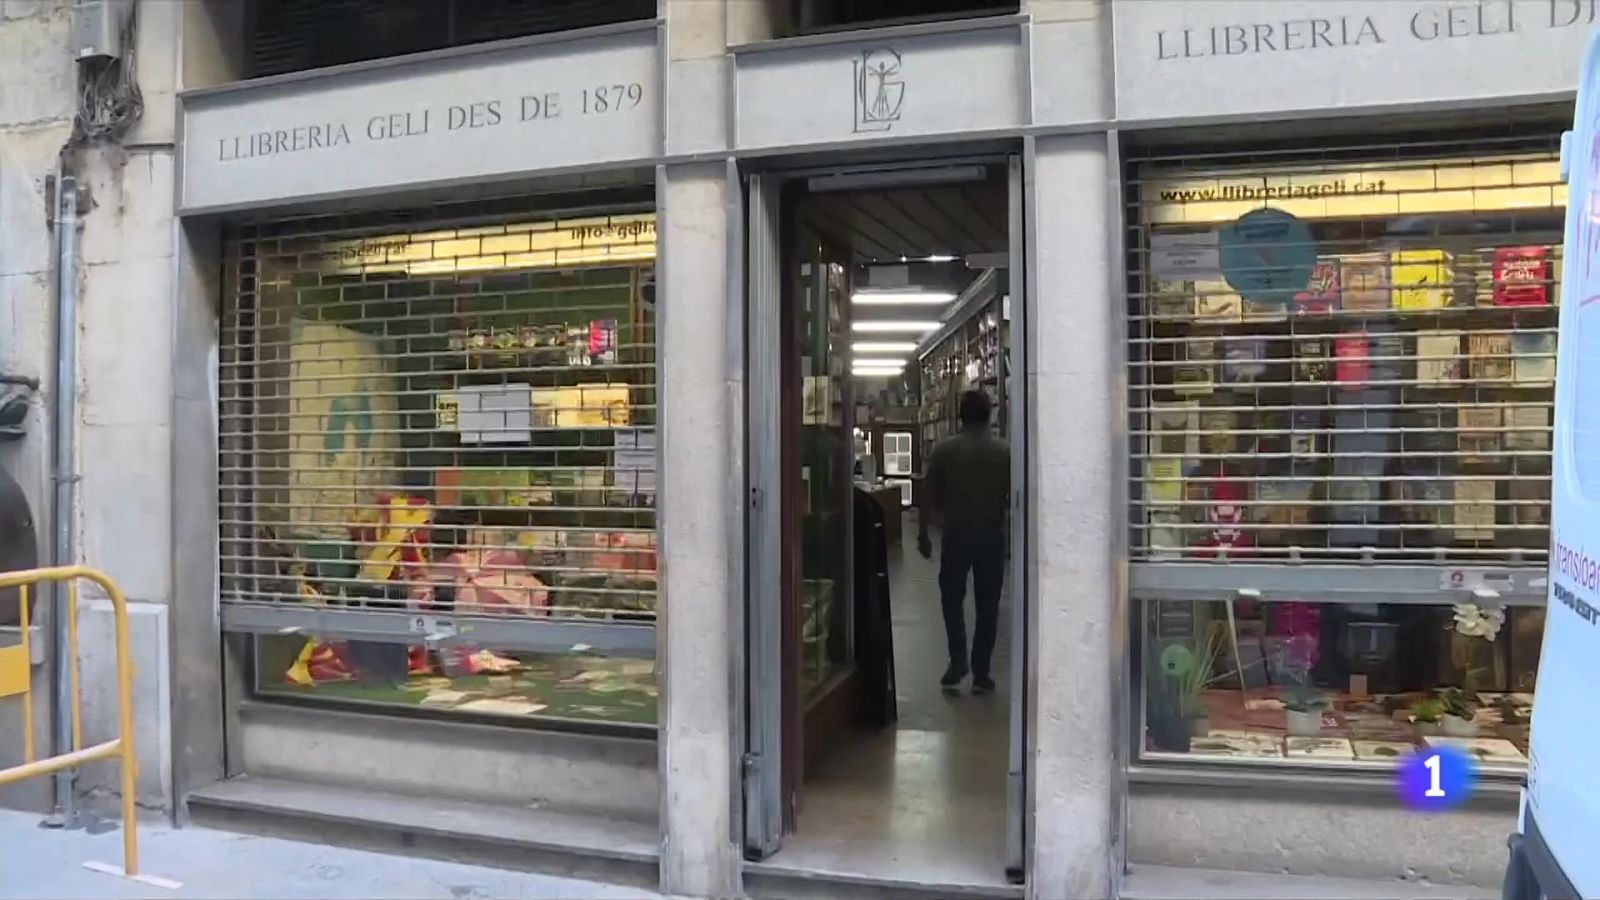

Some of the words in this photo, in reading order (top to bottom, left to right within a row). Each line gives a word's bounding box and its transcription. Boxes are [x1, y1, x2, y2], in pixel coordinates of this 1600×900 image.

[1156, 15, 1385, 60] LLIBRERIA
[1410, 0, 1515, 41] GELI
[218, 123, 351, 162] LLIBRERIA
[366, 109, 430, 141] GELI
[447, 100, 502, 131] DES
[519, 92, 561, 122] DE
[582, 83, 643, 115] 1879
